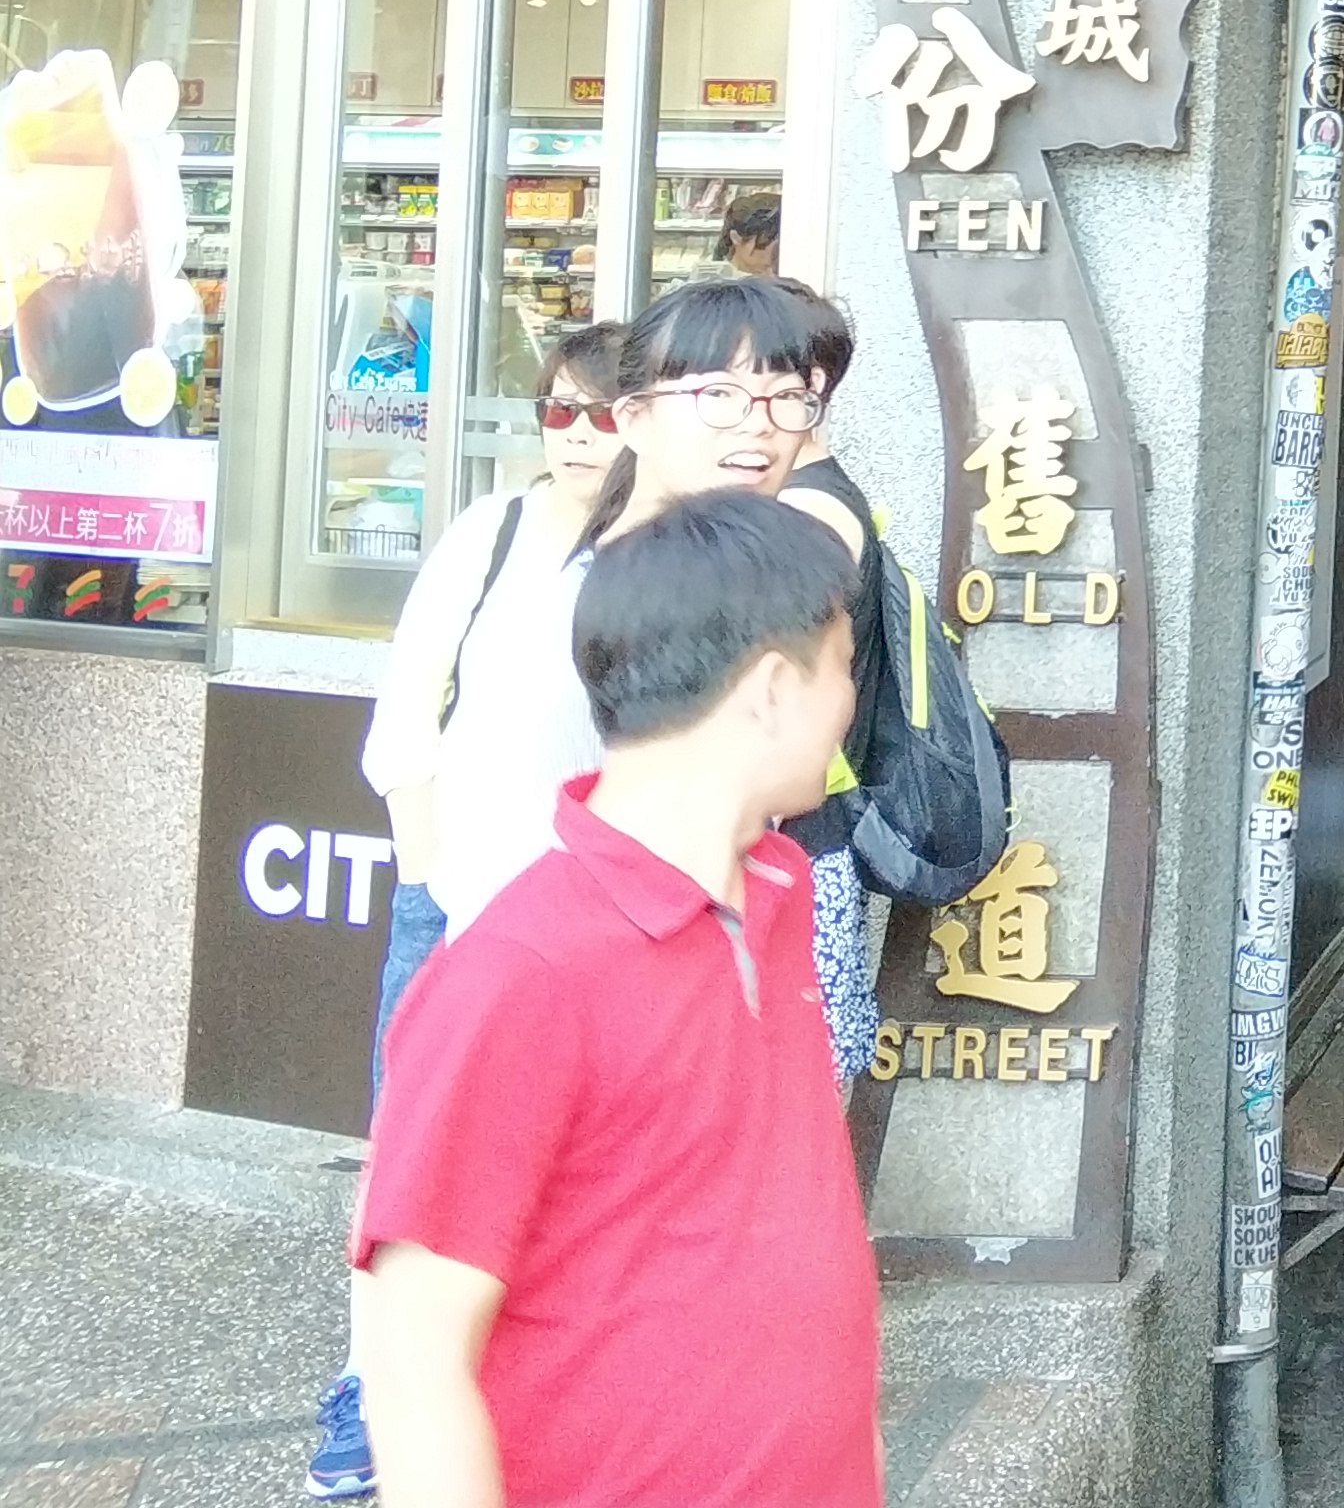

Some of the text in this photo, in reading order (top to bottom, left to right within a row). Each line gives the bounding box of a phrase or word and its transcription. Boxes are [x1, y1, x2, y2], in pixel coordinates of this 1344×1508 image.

[907, 200, 1046, 251] FEN
[963, 390, 1077, 554] 舊
[957, 570, 1118, 624] OLD
[245, 824, 392, 925] CIT
[930, 841, 1081, 1014] 道
[870, 1026, 1113, 1082] STREET
